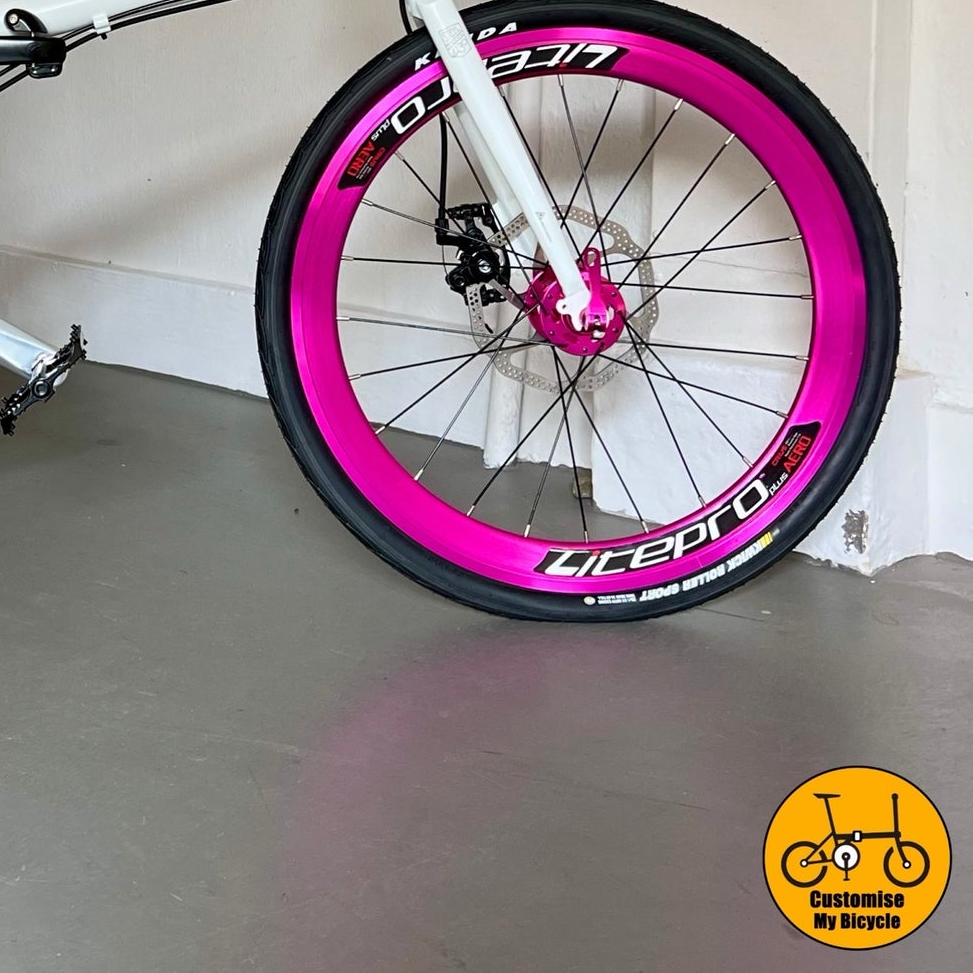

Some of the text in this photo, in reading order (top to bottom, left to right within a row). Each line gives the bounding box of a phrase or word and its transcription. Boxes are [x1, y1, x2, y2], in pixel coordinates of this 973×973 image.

[414, 22, 518, 71] KDA
[783, 435, 812, 473] AERO
[639, 583, 680, 602] SPORT
[682, 563, 726, 592] ROLLER
